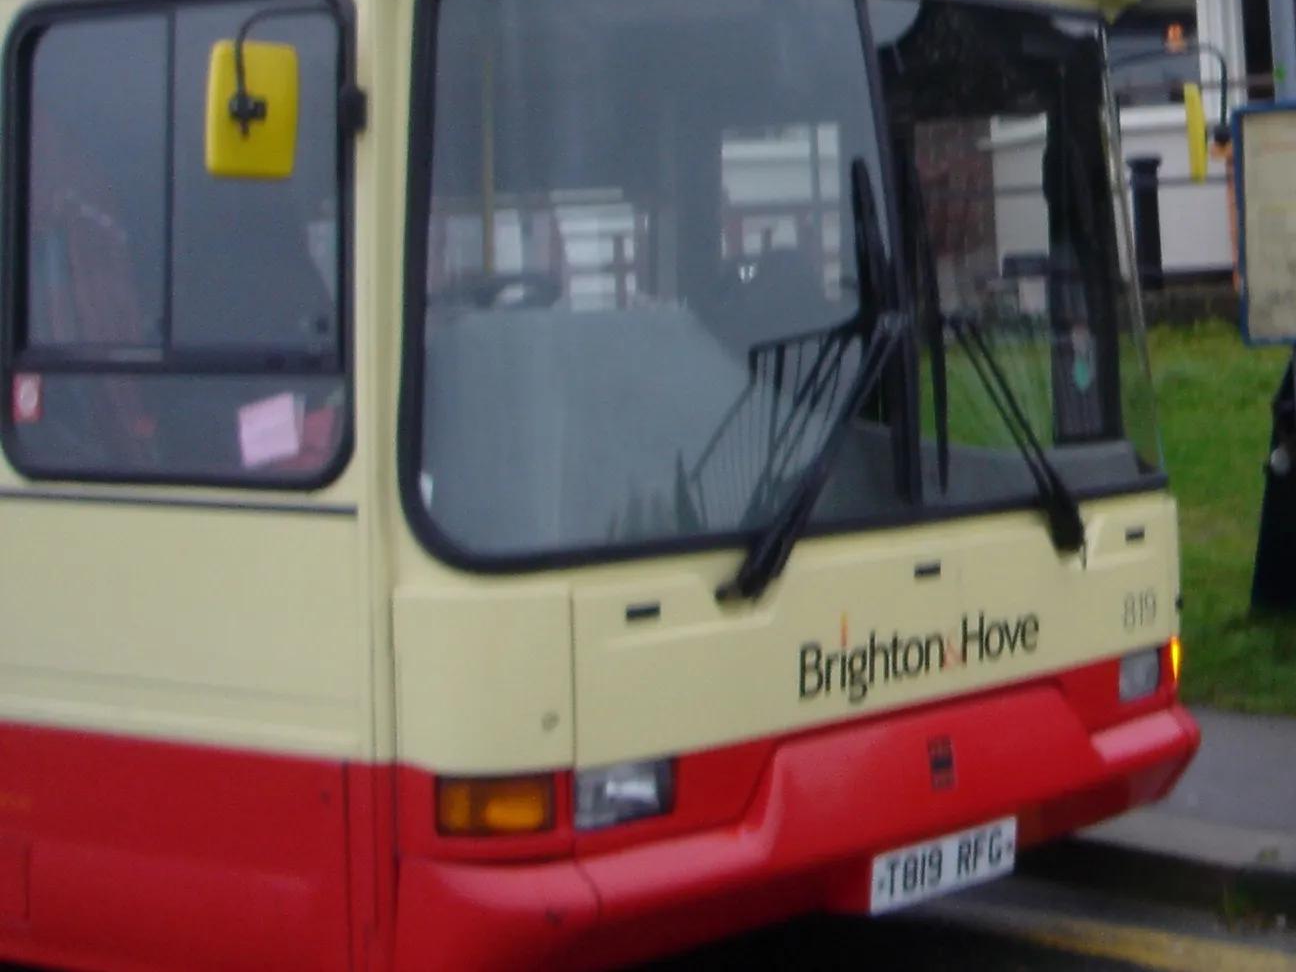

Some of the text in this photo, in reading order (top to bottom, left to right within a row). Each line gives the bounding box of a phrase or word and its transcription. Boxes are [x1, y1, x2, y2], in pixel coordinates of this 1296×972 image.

[1122, 590, 1157, 630] 819
[799, 612, 944, 704] Brighton
[961, 609, 1040, 666] Hove
[887, 843, 942, 898] T819
